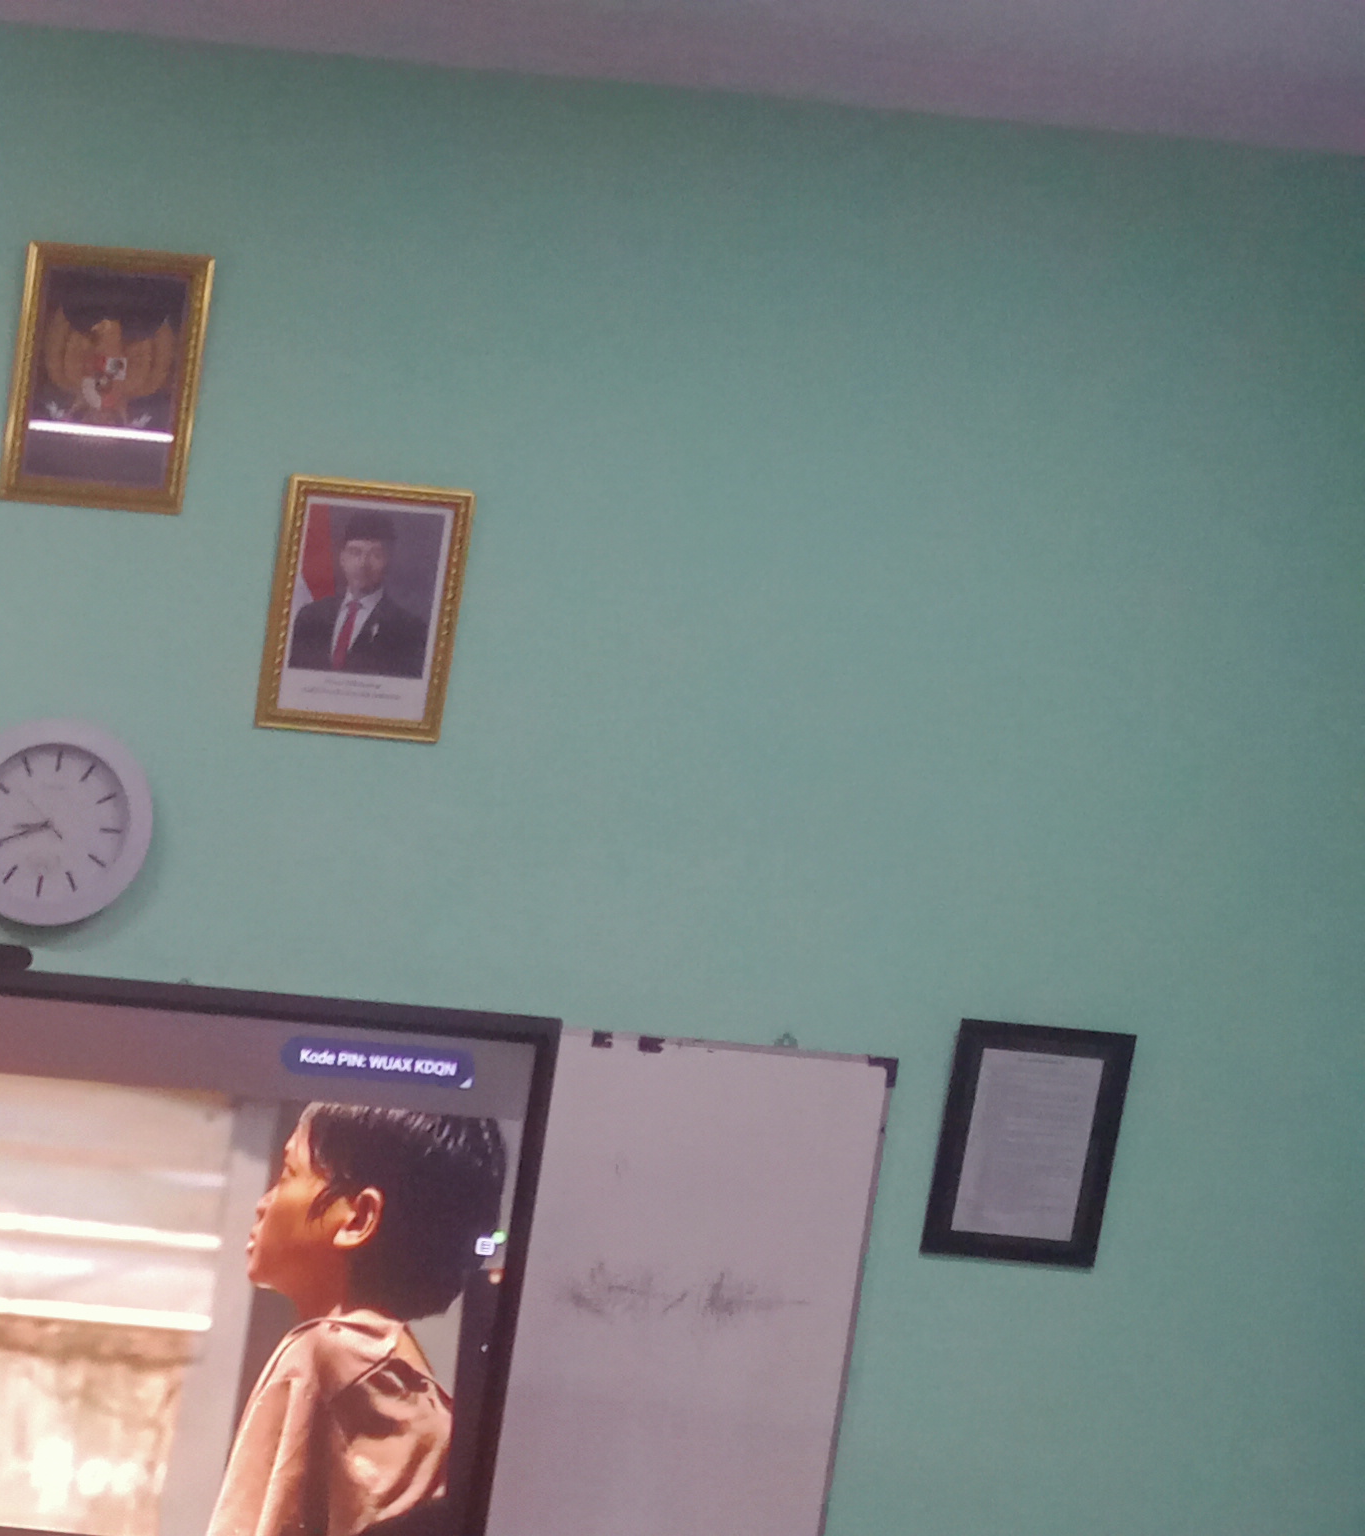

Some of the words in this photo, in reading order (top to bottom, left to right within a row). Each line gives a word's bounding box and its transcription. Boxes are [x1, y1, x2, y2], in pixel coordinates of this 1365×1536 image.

[299, 1048, 336, 1065] Kode
[337, 1052, 367, 1068] PIN:
[368, 1055, 414, 1073] WUAX
